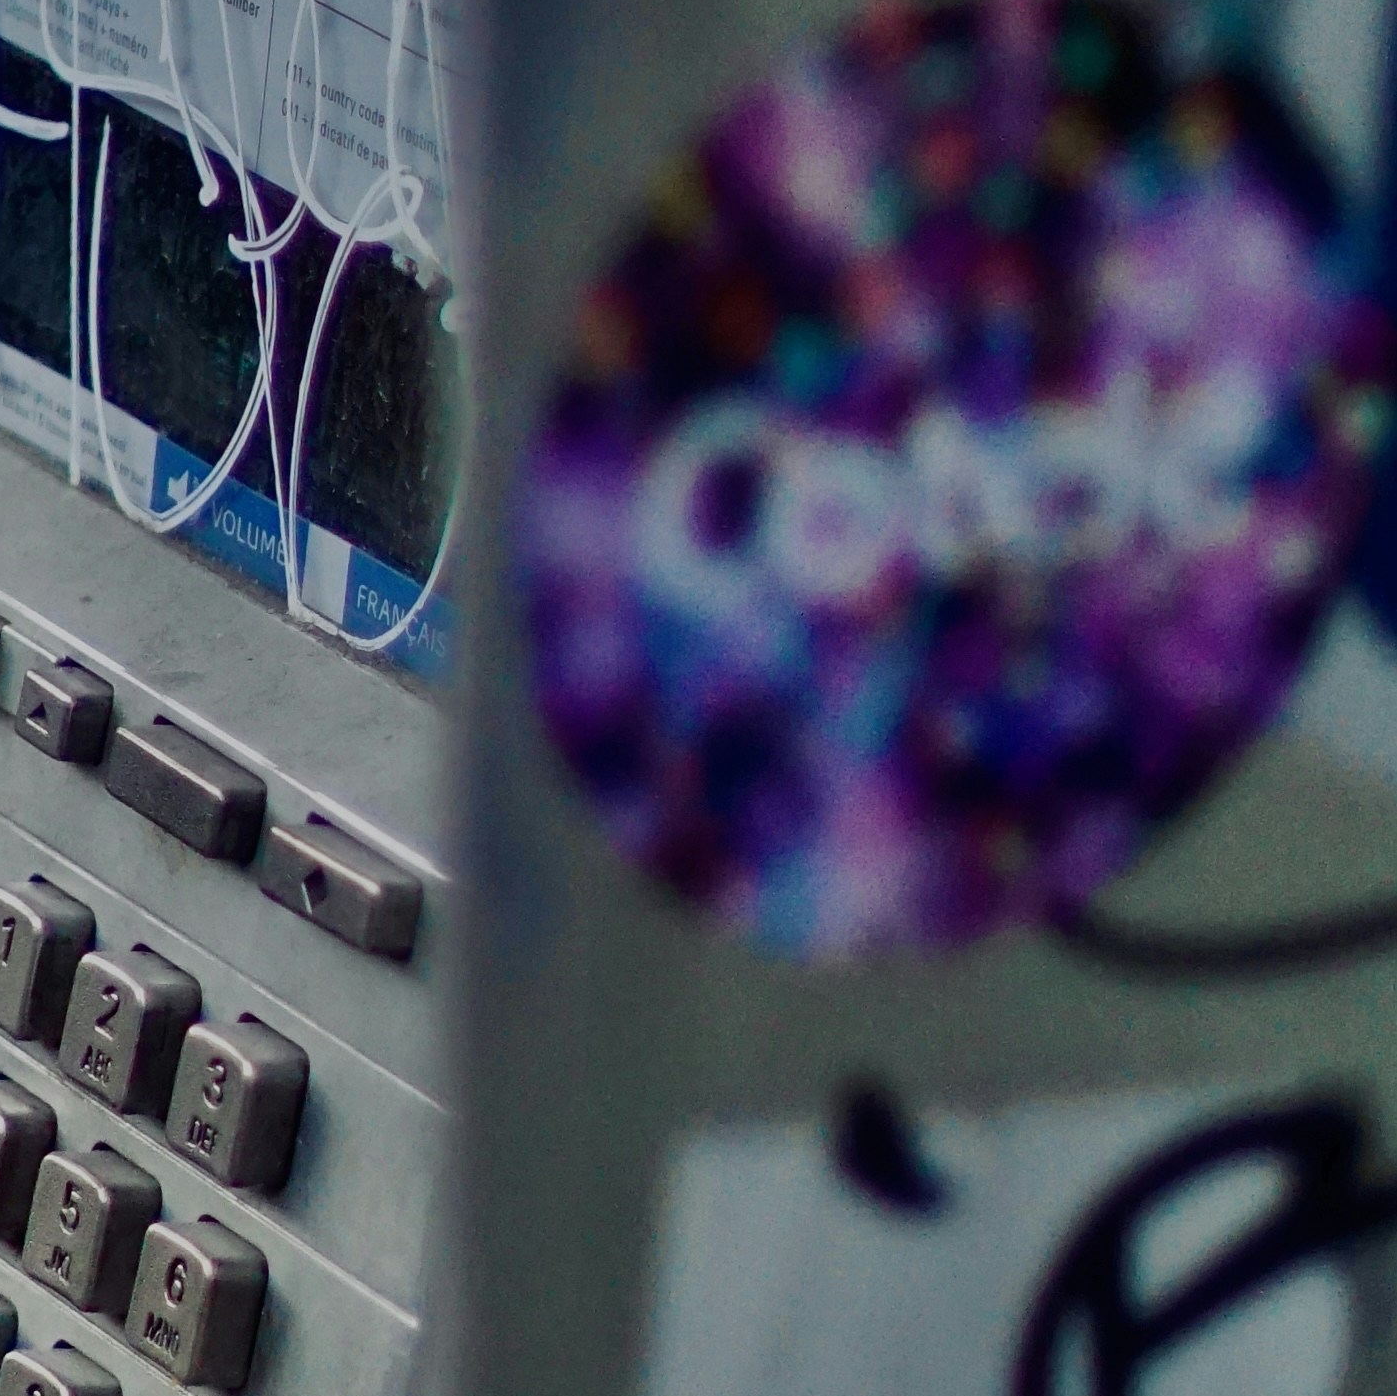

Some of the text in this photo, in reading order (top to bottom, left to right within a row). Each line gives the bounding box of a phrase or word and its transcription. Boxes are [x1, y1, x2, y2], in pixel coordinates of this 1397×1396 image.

[108, 23, 148, 60] numéro
[318, 79, 357, 118] ountry
[357, 99, 386, 130] code
[309, 111, 355, 153] idicatif
[355, 137, 370, 162] de
[0, 916, 17, 968] 1
[95, 986, 121, 1041] 2
[203, 1058, 227, 1110] 3
[60, 1180, 82, 1236] 5
[164, 1257, 188, 1308] 6
